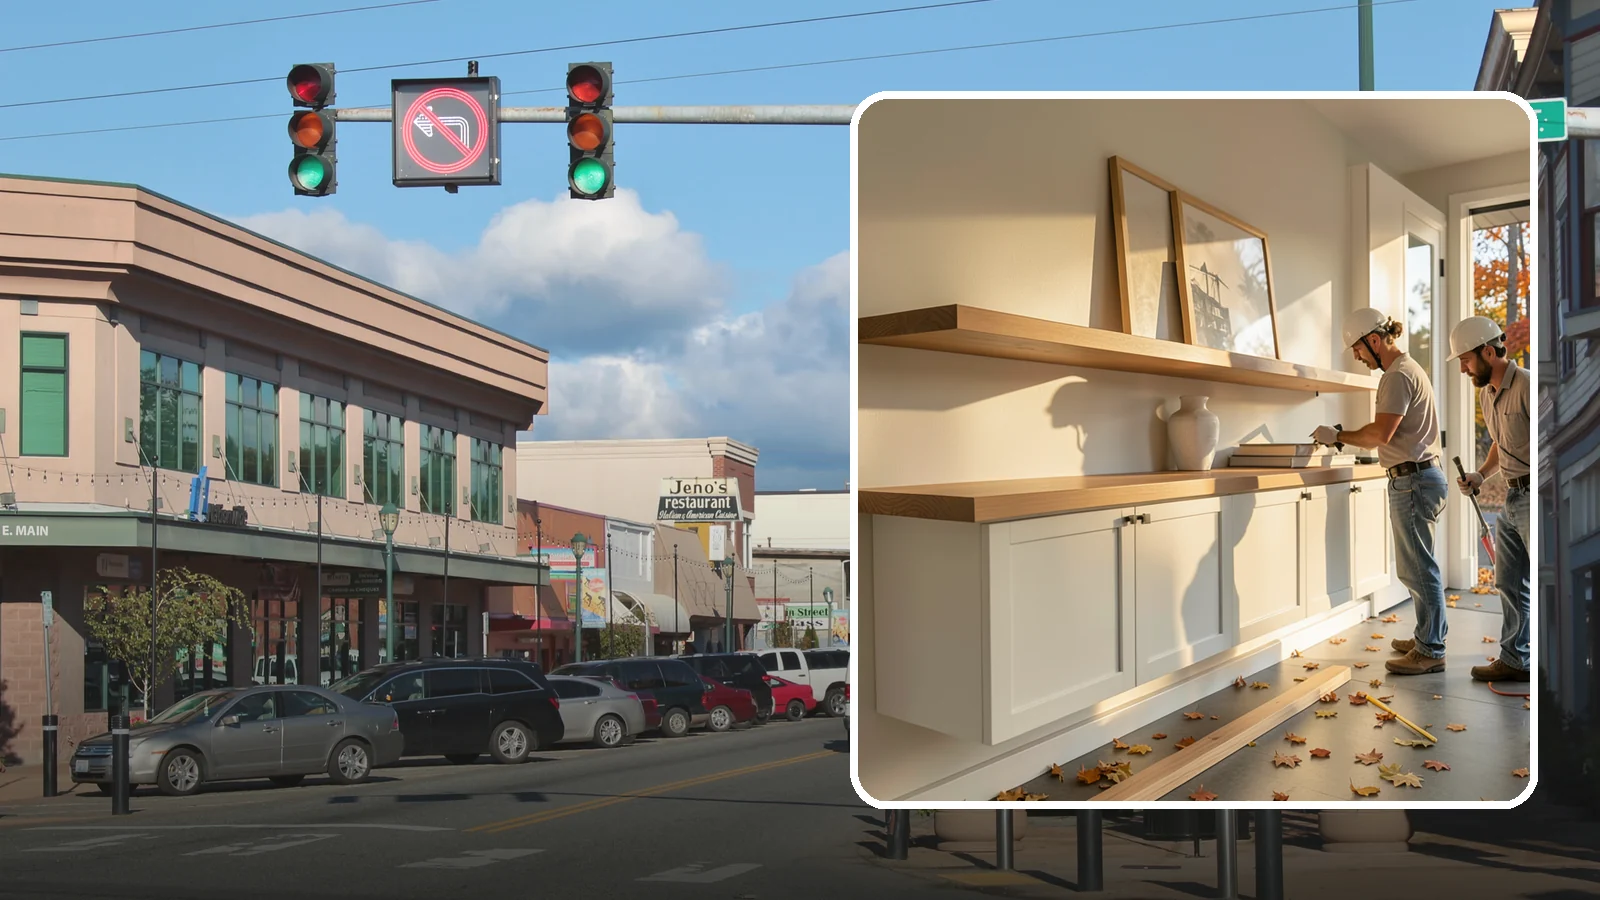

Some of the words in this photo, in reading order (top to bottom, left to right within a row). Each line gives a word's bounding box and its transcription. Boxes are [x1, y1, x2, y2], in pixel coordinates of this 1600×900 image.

[670, 480, 728, 494] Jeno's
[665, 496, 731, 509] restaurant
[659, 509, 681, 519] Italian
[686, 509, 714, 519] American
[715, 509, 737, 519] Cuisine
[2, 525, 13, 536] E.
[15, 525, 49, 536] MAIN
[797, 608, 828, 617] Street
